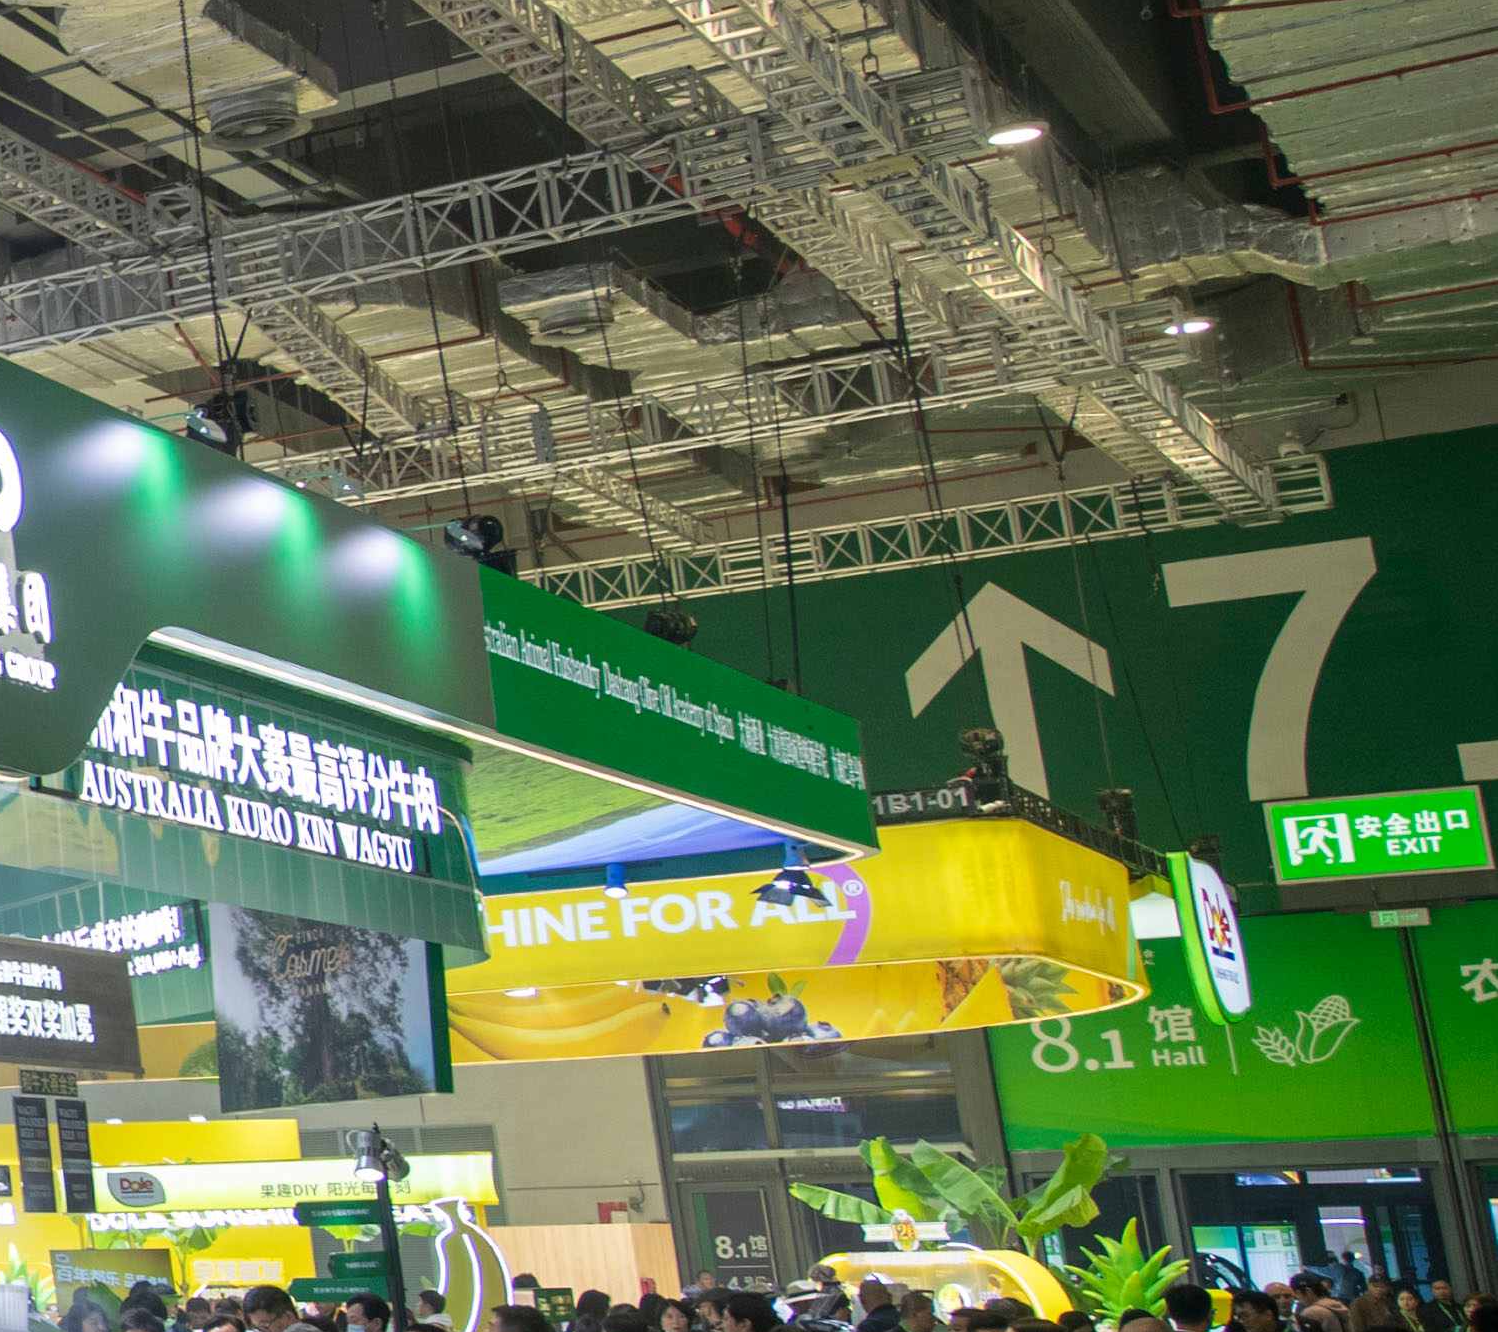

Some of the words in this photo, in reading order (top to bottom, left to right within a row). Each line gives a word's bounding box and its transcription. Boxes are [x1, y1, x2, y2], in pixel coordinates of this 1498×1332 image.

[5, 649, 56, 689] GROUP
[1161, 536, 1378, 802] 7
[80, 760, 224, 832] AUSTRALIA
[224, 794, 294, 848] KURO
[294, 811, 339, 857] KIN
[338, 822, 414, 873] WAGYU
[1353, 808, 1472, 839] 安全出口
[1387, 835, 1443, 857] EXIT
[621, 891, 737, 938] FOR
[1147, 1004, 1197, 1045] 馆
[1151, 1044, 1207, 1068] Hall
[119, 1177, 155, 1193] Dole
[327, 1180, 413, 1198] 阳光每刻
[715, 1235, 749, 1259] 8.1
